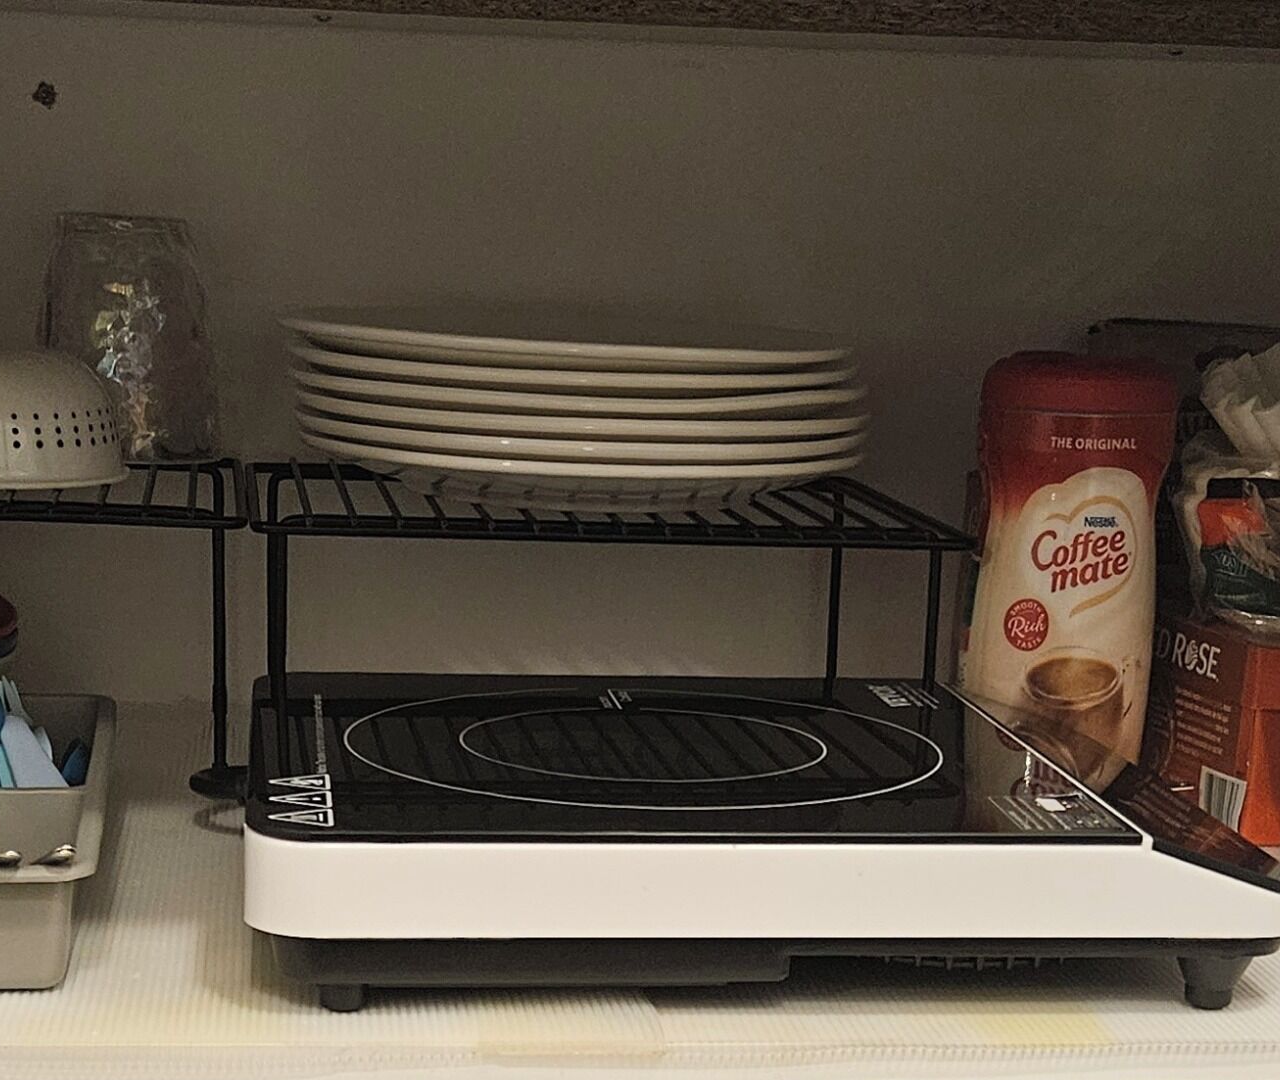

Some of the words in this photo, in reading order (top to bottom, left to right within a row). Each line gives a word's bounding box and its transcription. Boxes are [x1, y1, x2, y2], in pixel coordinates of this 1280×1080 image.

[1050, 436, 1072, 449] THE
[1075, 437, 1137, 450] ORIGINAL
[1031, 529, 1126, 572] Coffee
[1050, 552, 1129, 593] mate
[1007, 614, 1046, 638] Rich
